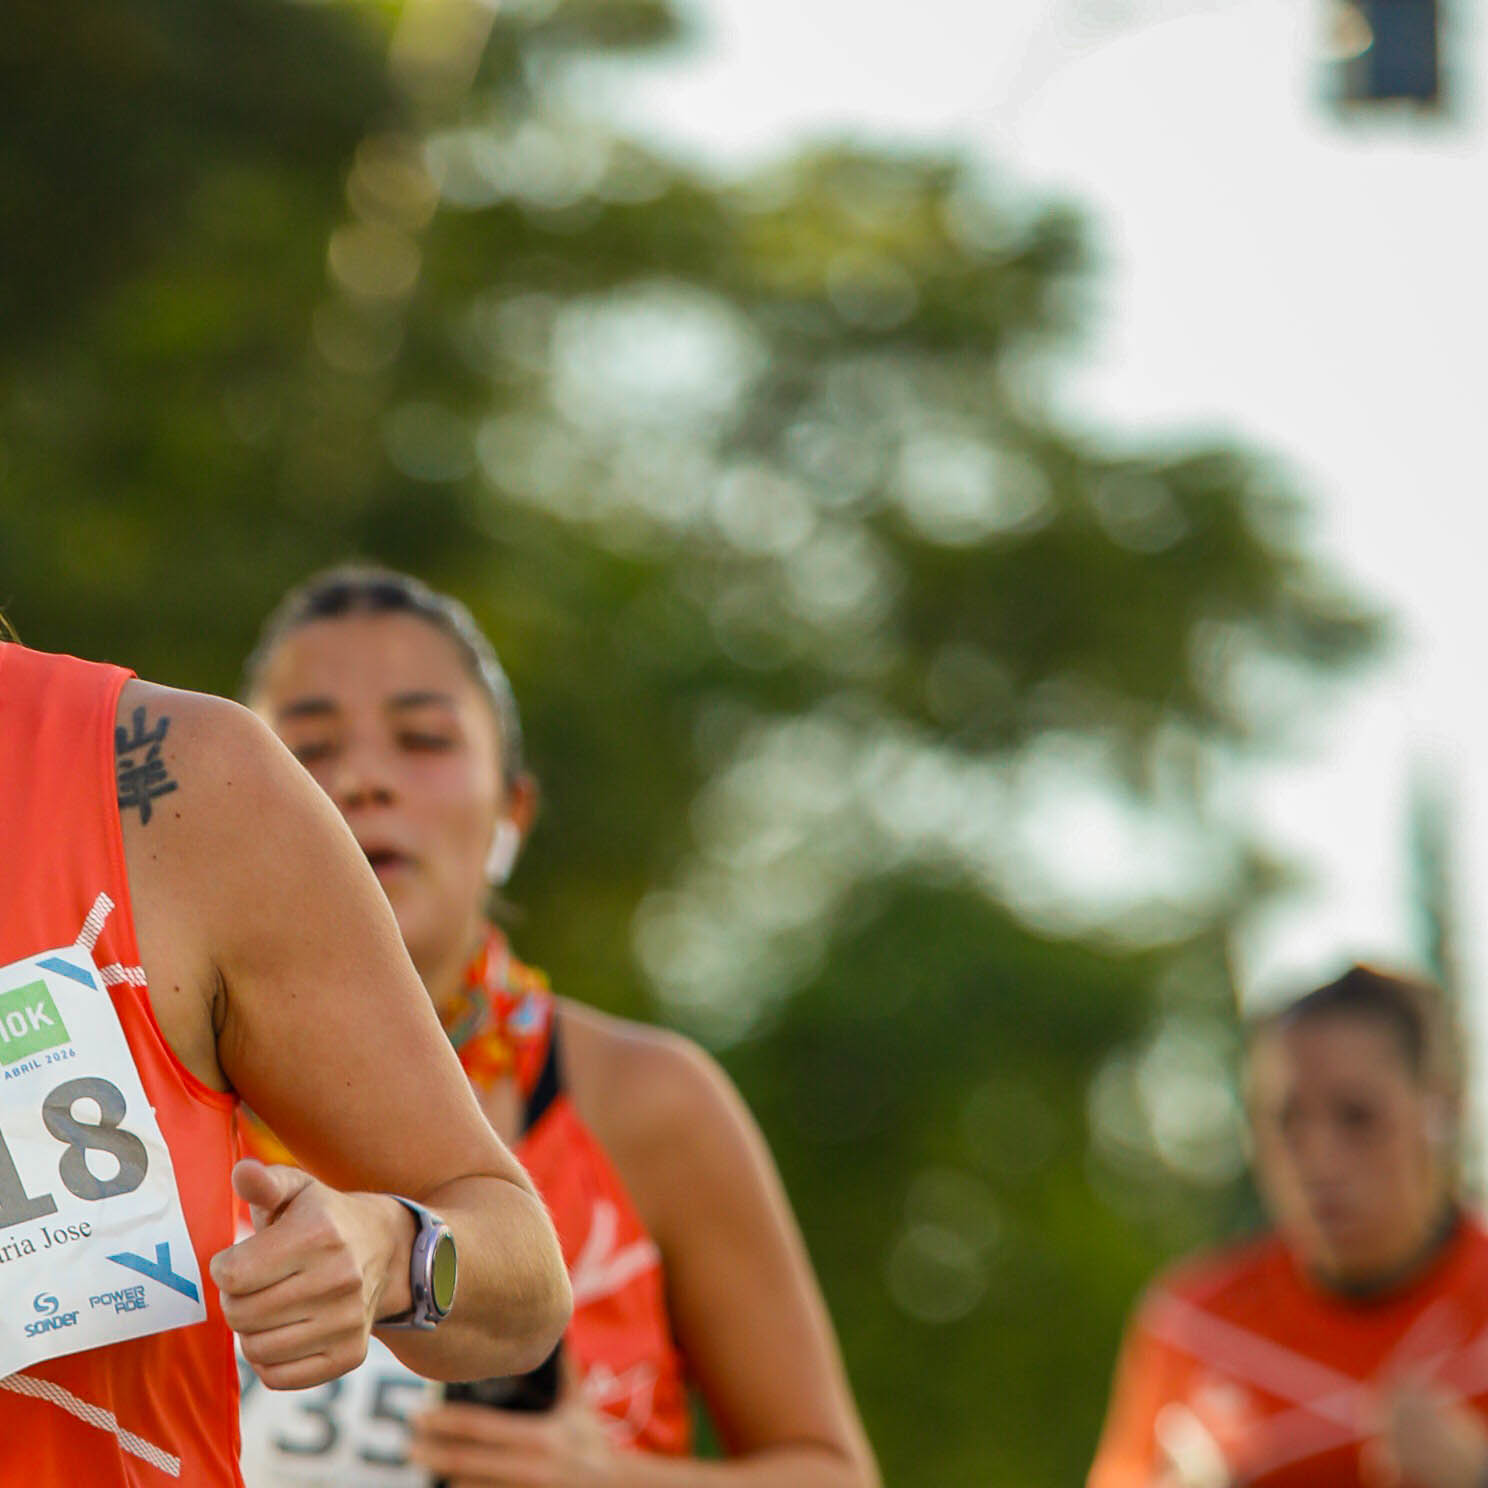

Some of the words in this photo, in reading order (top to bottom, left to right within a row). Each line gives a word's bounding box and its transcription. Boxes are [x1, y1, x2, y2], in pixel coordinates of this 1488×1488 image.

[4, 1059, 42, 1081] ABRIL
[45, 1047, 77, 1064] 2026
[41, 1220, 93, 1250] Jose
[88, 1284, 146, 1309] POWER
